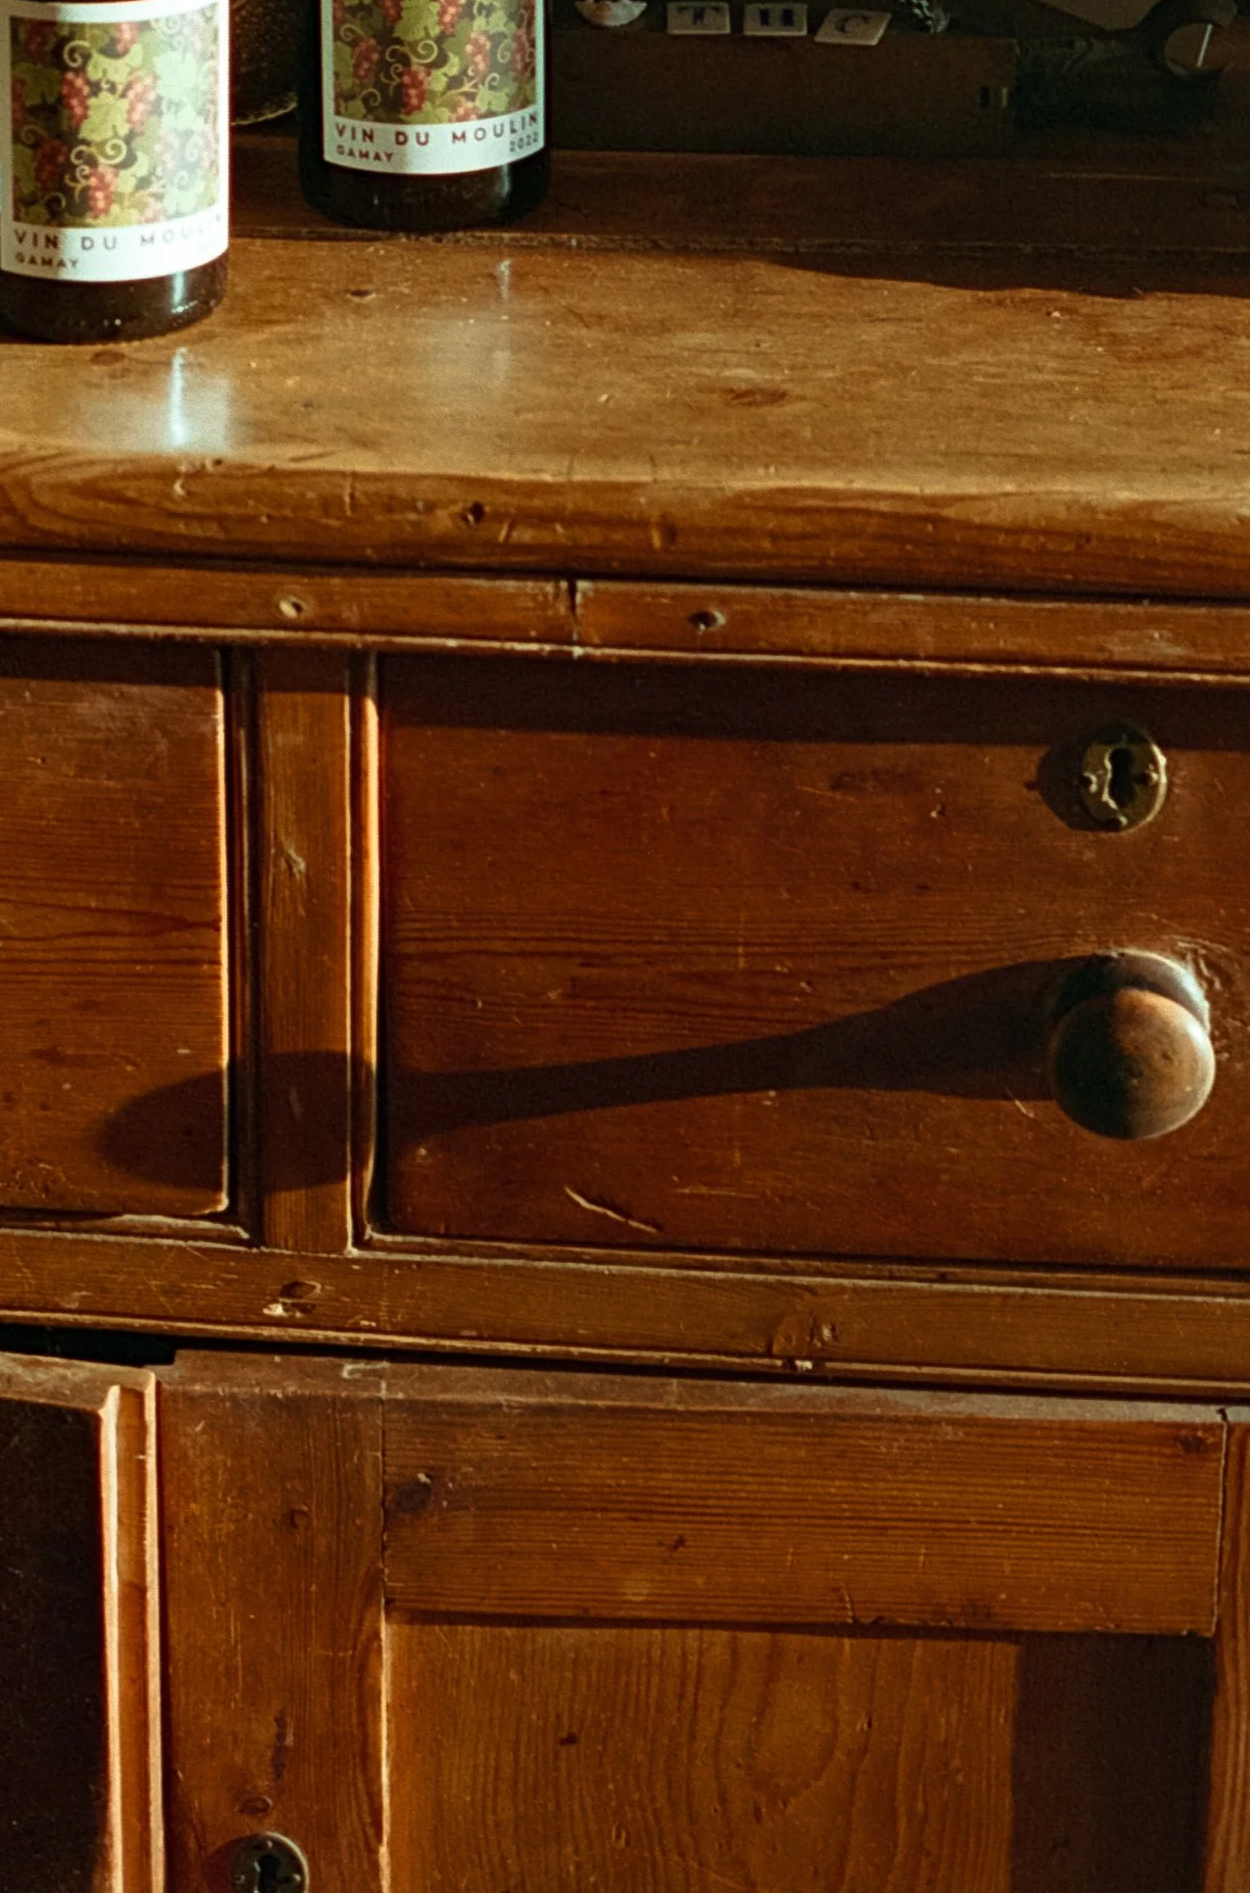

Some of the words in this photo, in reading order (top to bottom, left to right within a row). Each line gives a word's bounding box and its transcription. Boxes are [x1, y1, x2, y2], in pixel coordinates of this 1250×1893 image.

[335, 122, 374, 144] VIN
[395, 131, 430, 147] DU
[452, 112, 538, 144] MOULIN
[336, 145, 394, 163] GAMAY
[14, 228, 59, 249] VIN
[80, 236, 118, 252] DU
[15, 252, 79, 269] GAMAY
